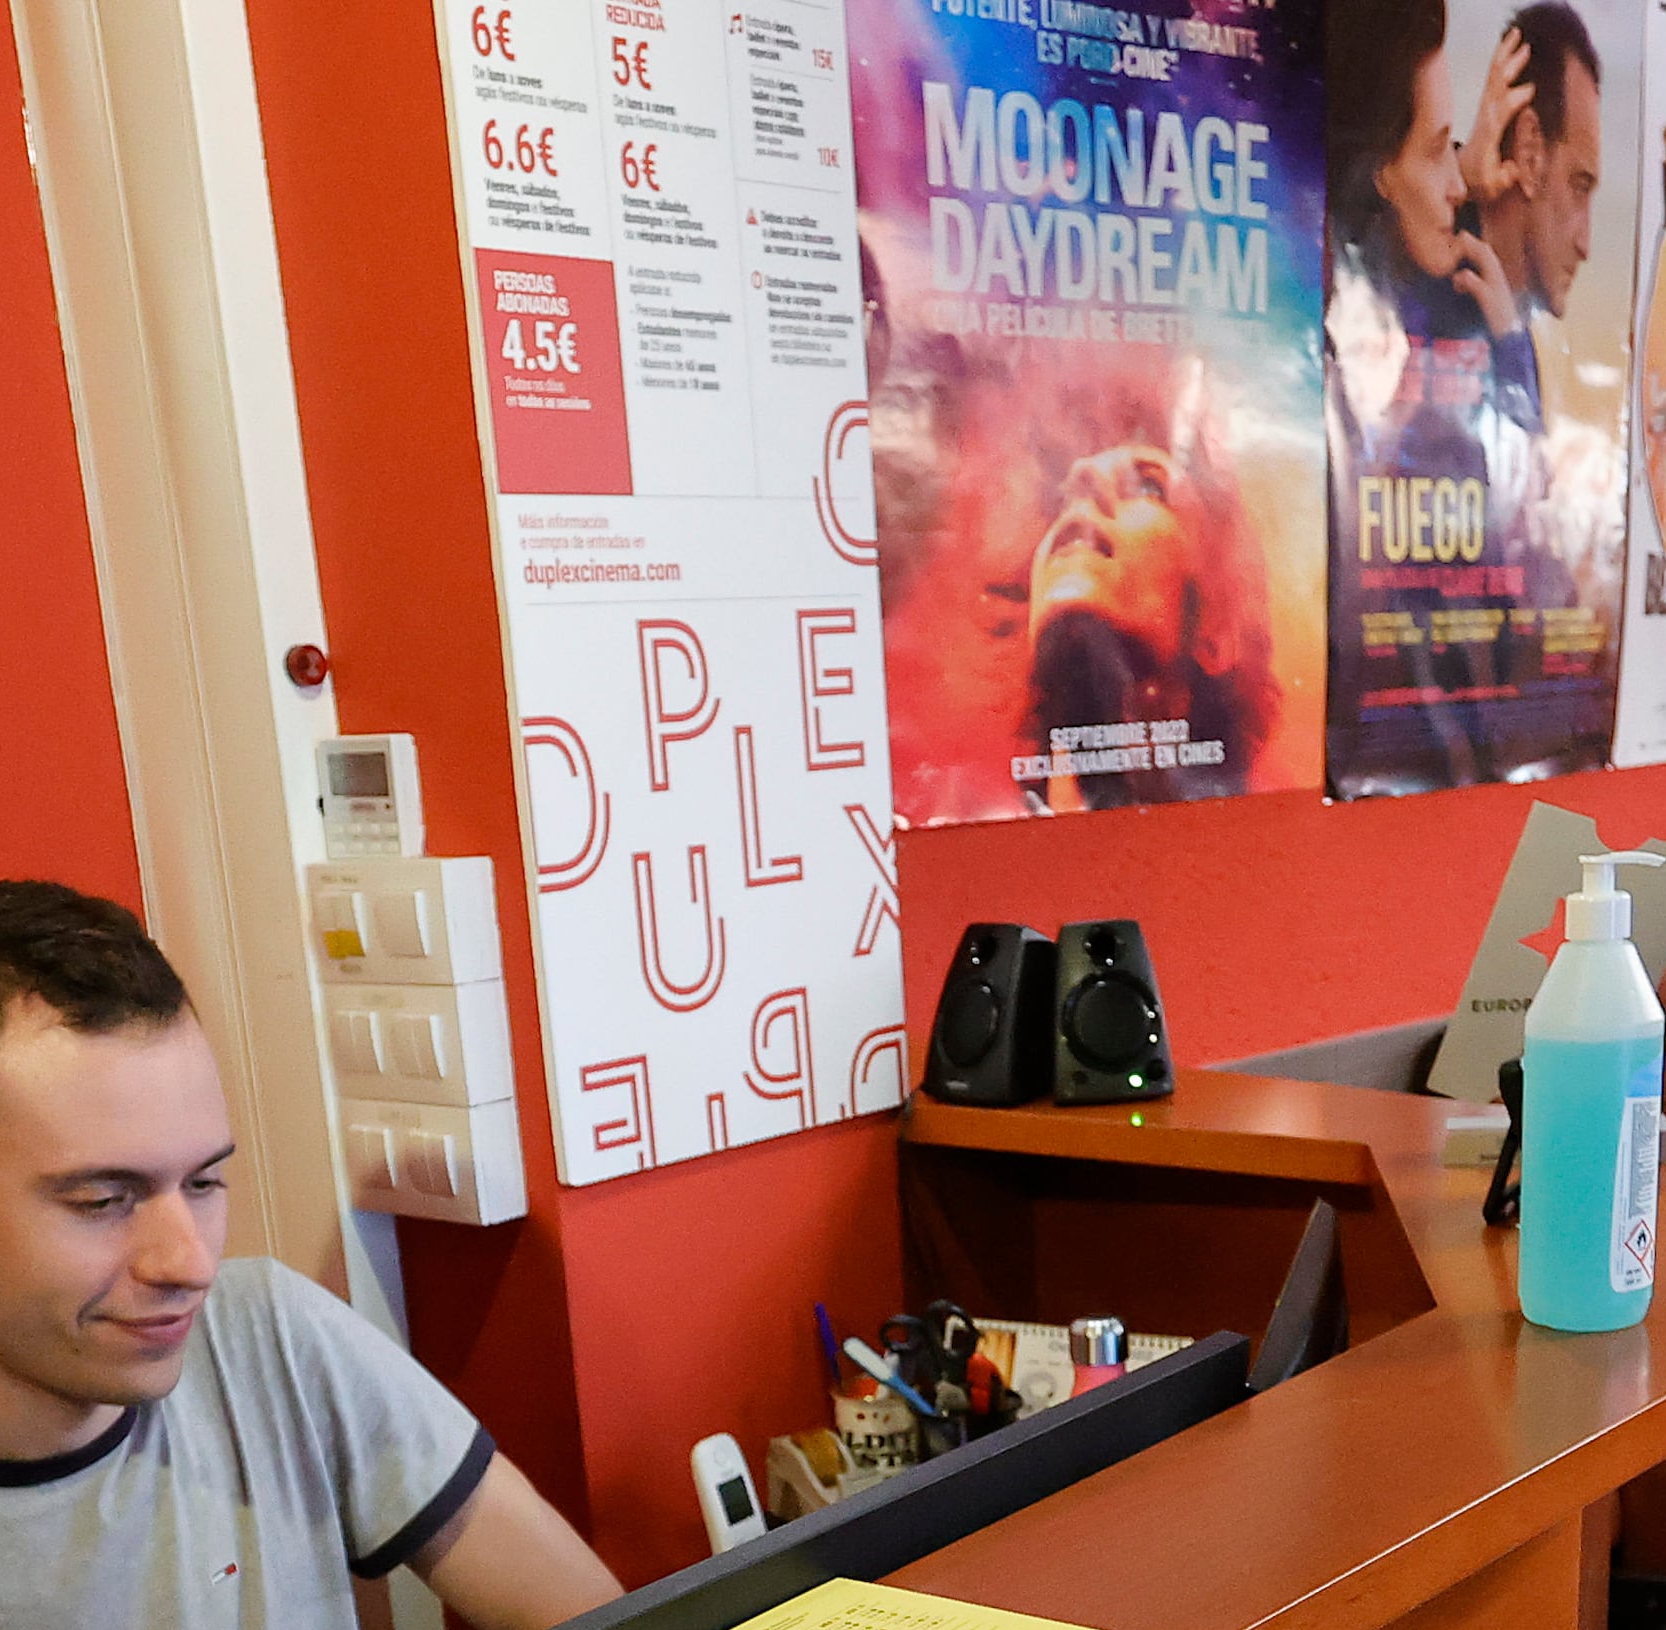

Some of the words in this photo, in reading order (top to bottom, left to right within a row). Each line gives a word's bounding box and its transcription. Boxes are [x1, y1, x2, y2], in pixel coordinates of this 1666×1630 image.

[471, 5, 515, 61] 6€
[606, 4, 665, 31] REDUCIDA
[1040, 0, 1144, 44] LUMINOSA
[1146, 15, 1164, 46] Y
[612, 36, 652, 90] 5€
[1037, 30, 1063, 64] ES
[483, 118, 558, 177] 6.6€
[621, 141, 661, 192] 6€
[921, 81, 1271, 220] MOONAGE
[929, 196, 1269, 313] DAYDREAM
[493, 269, 556, 294] PERSOAS
[496, 291, 571, 317] ABONADAS
[501, 318, 582, 374] 4.5€
[1358, 476, 1484, 563] FUEGO
[524, 557, 681, 590] duplexcinema.com
